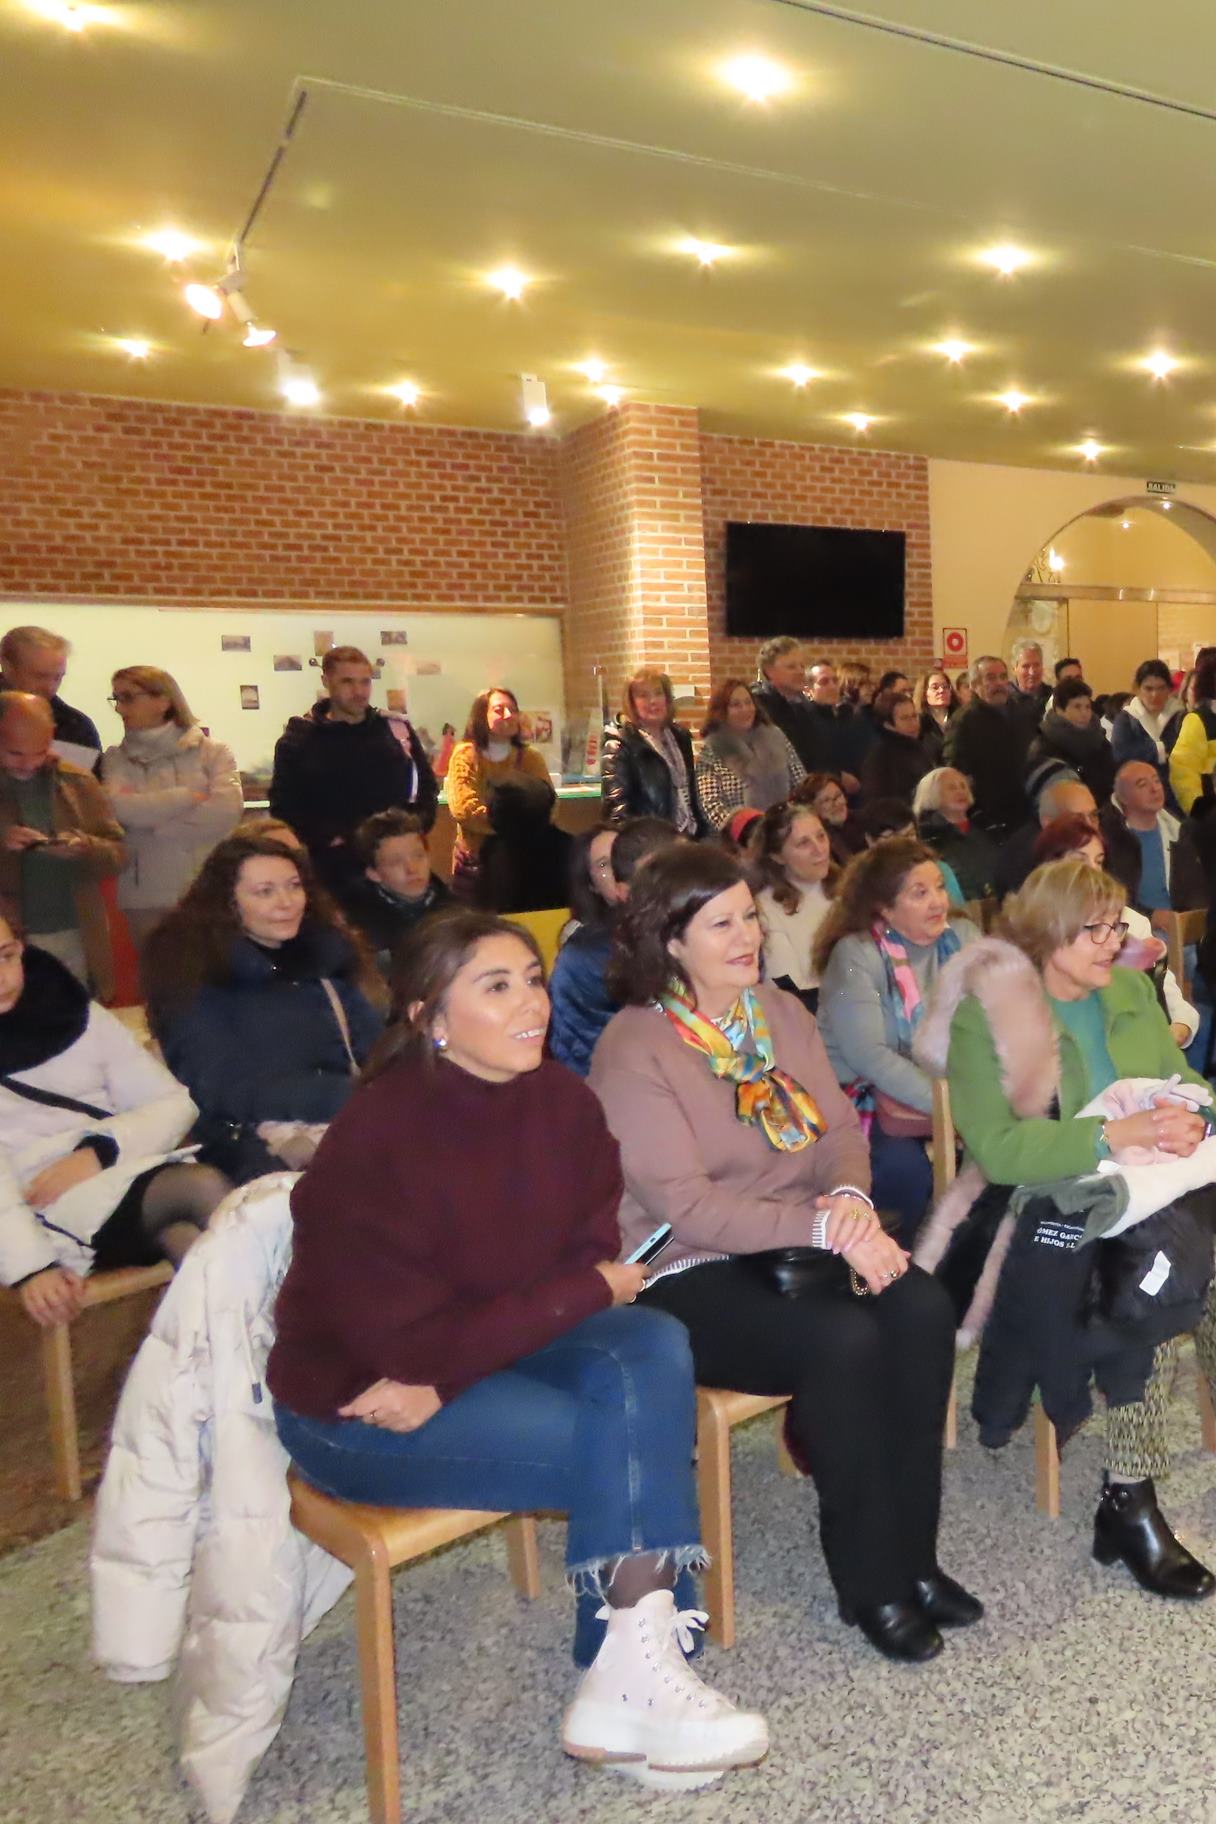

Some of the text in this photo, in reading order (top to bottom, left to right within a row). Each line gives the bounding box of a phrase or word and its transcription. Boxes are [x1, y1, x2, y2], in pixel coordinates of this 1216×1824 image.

[1148, 482, 1175, 492] SALIDA
[1037, 1227, 1059, 1237] ÓMEZ
[1041, 1236, 1065, 1248] HIJOS
